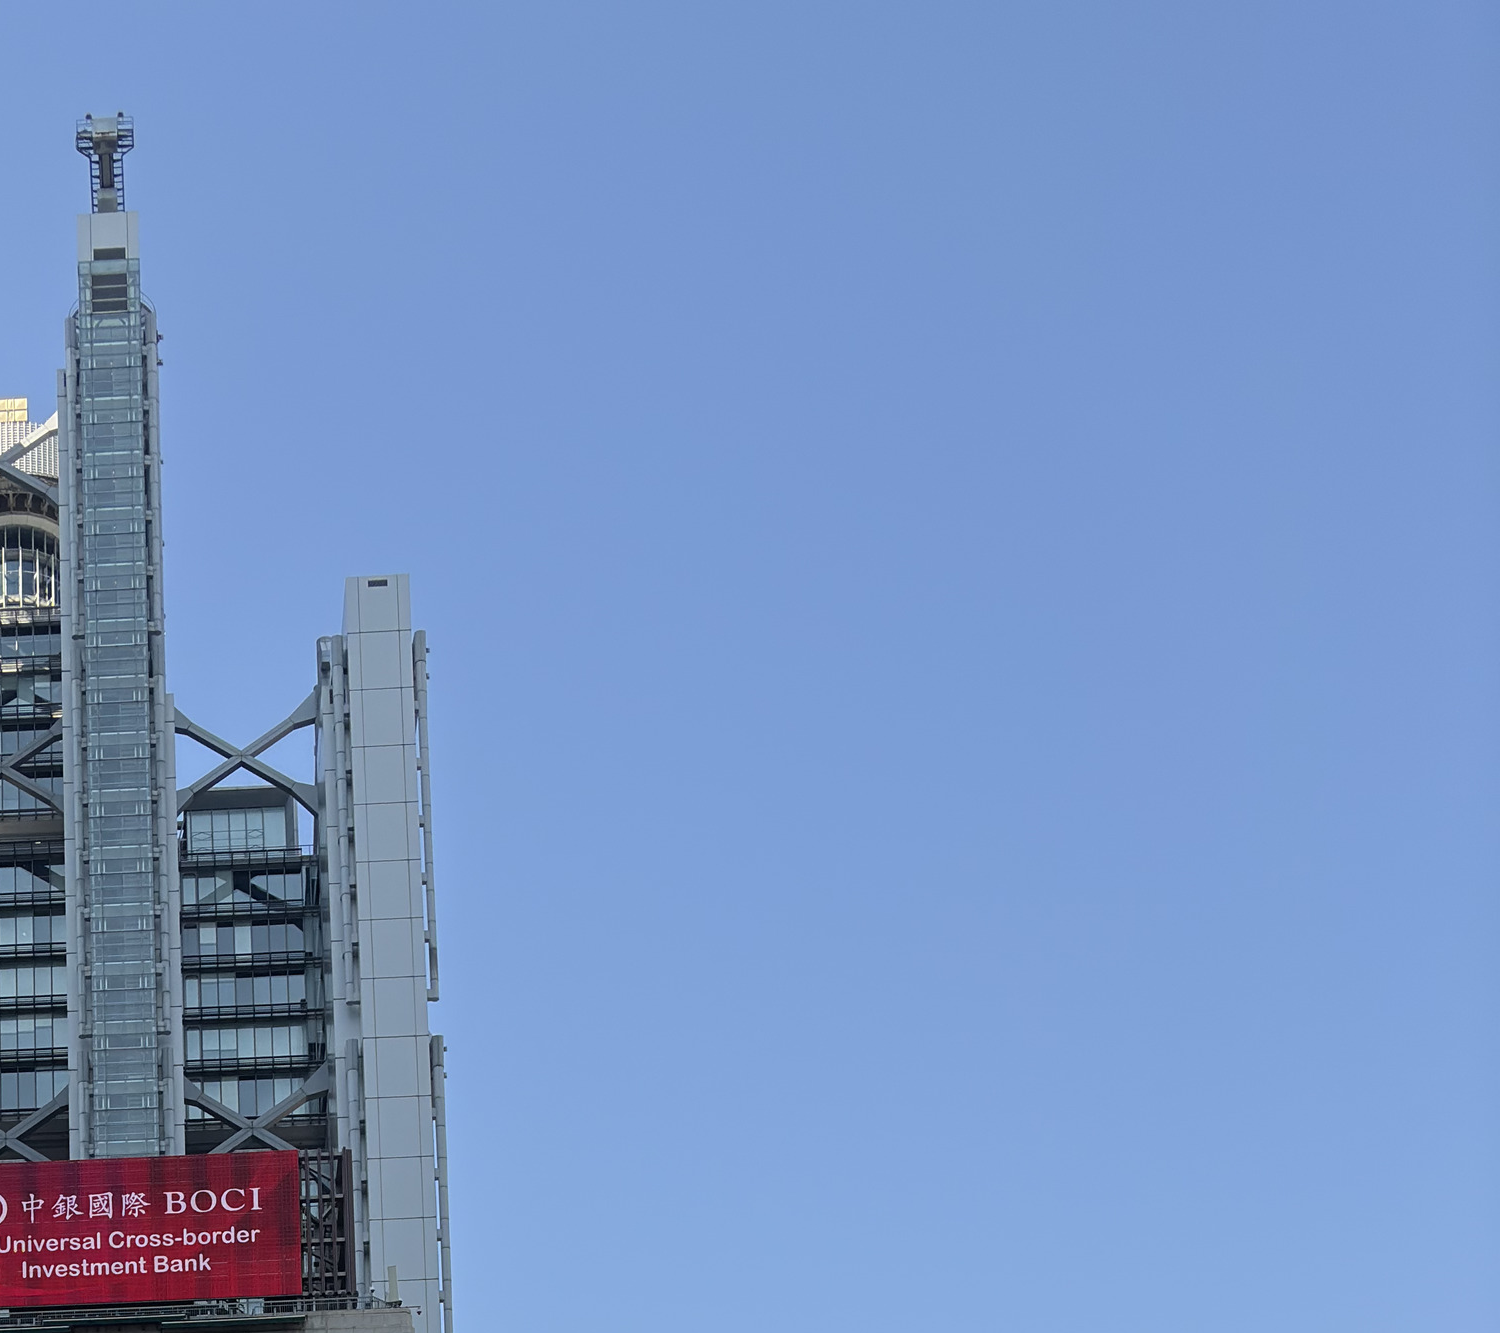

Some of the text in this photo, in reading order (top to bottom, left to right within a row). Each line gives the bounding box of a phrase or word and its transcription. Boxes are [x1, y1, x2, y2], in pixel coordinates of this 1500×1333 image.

[20, 1186, 263, 1224] 中銀國際 BOCI
[108, 1226, 261, 1249] Cross-border
[21, 1253, 213, 1280] Investment Bank
